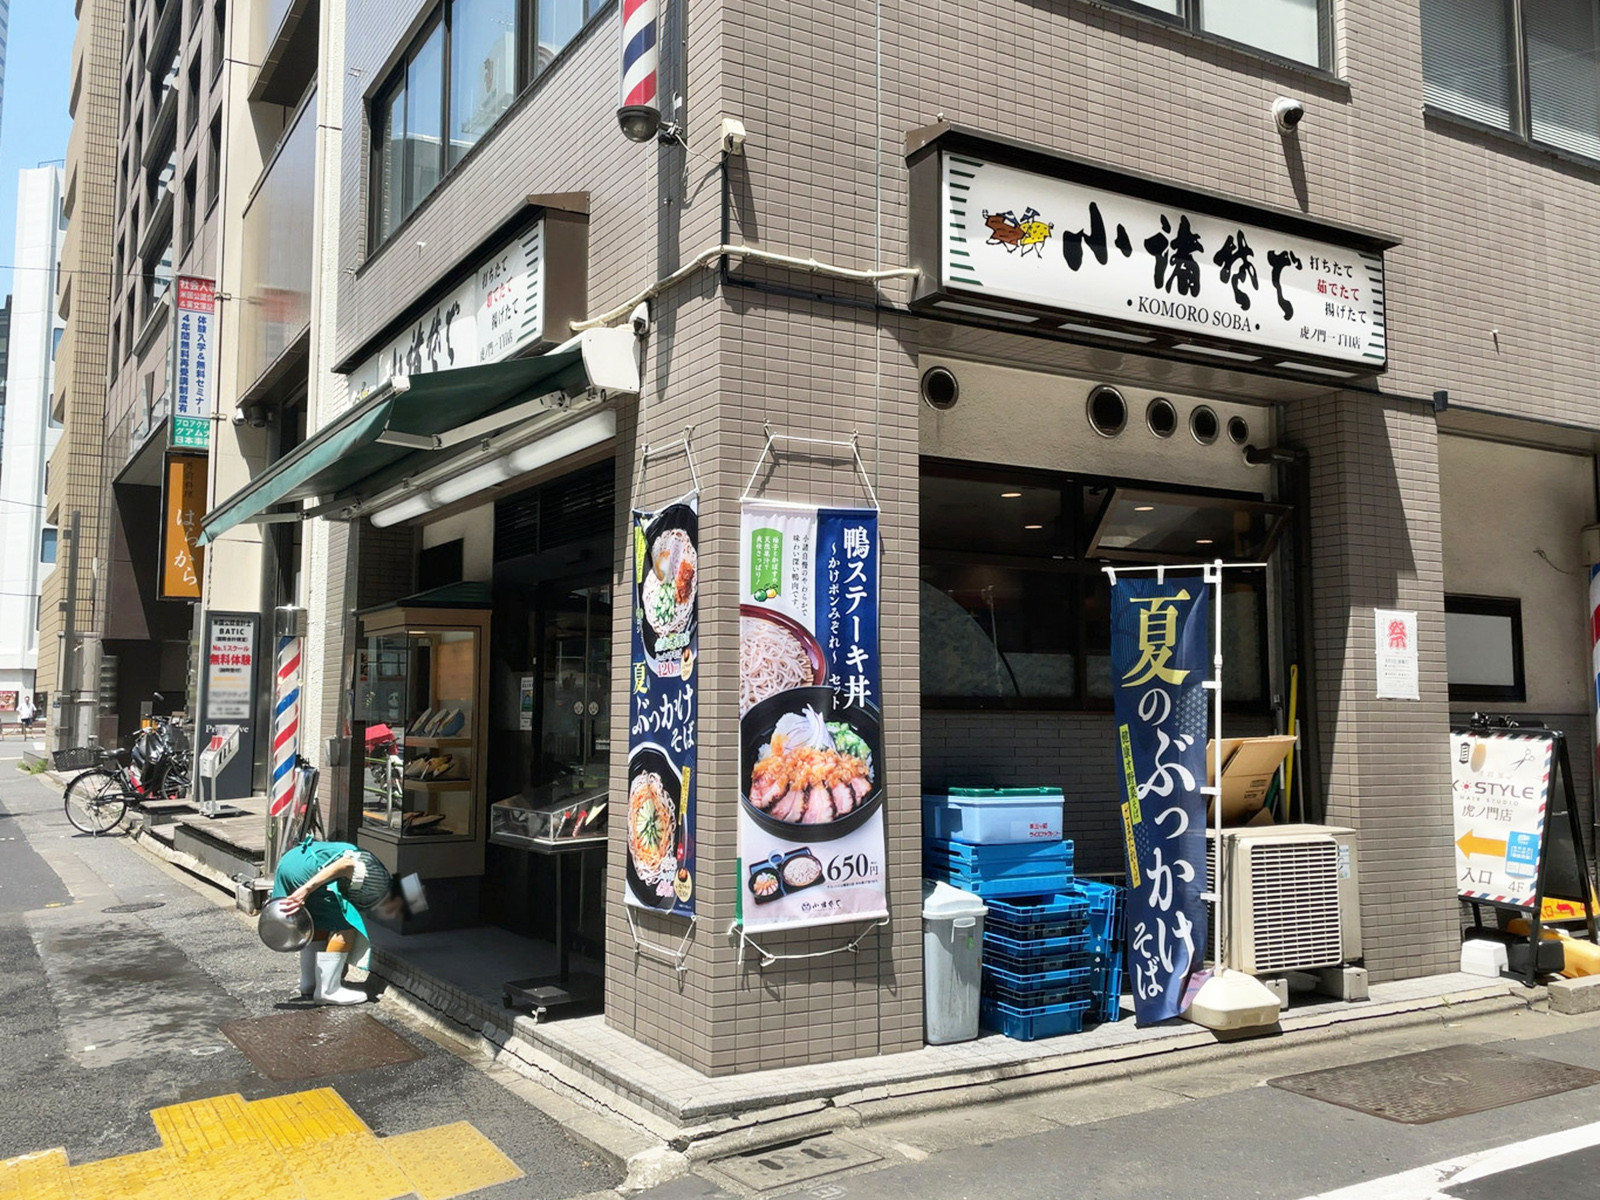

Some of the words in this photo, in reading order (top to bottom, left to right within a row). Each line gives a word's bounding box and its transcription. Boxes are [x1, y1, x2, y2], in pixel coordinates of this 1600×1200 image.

[481, 256, 508, 289] 打ちたて
[1309, 255, 1353, 278] 打ちたて
[1316, 278, 1360, 301] 茹でたて
[1138, 296, 1209, 324] KOMORO
[1212, 310, 1251, 332] SOBA
[1325, 302, 1367, 324] 揚げたて
[1300, 325, 1361, 349] 虎ノ門一丁目店
[842, 525, 872, 710] 鴨ステーキ丼
[209, 653, 251, 666] 無料体験
[632, 660, 649, 695] 夏
[829, 674, 842, 711] セット
[632, 683, 694, 737] ぶっかけ
[670, 721, 695, 752] そば
[1121, 588, 1197, 980] 夏のぶっかけ
[1474, 781, 1534, 800] STYLE
[1462, 804, 1513, 822] 虎ノ門店
[1461, 866, 1493, 886] 入口
[1508, 881, 1525, 893] 4F
[1133, 921, 1164, 1000] そば
